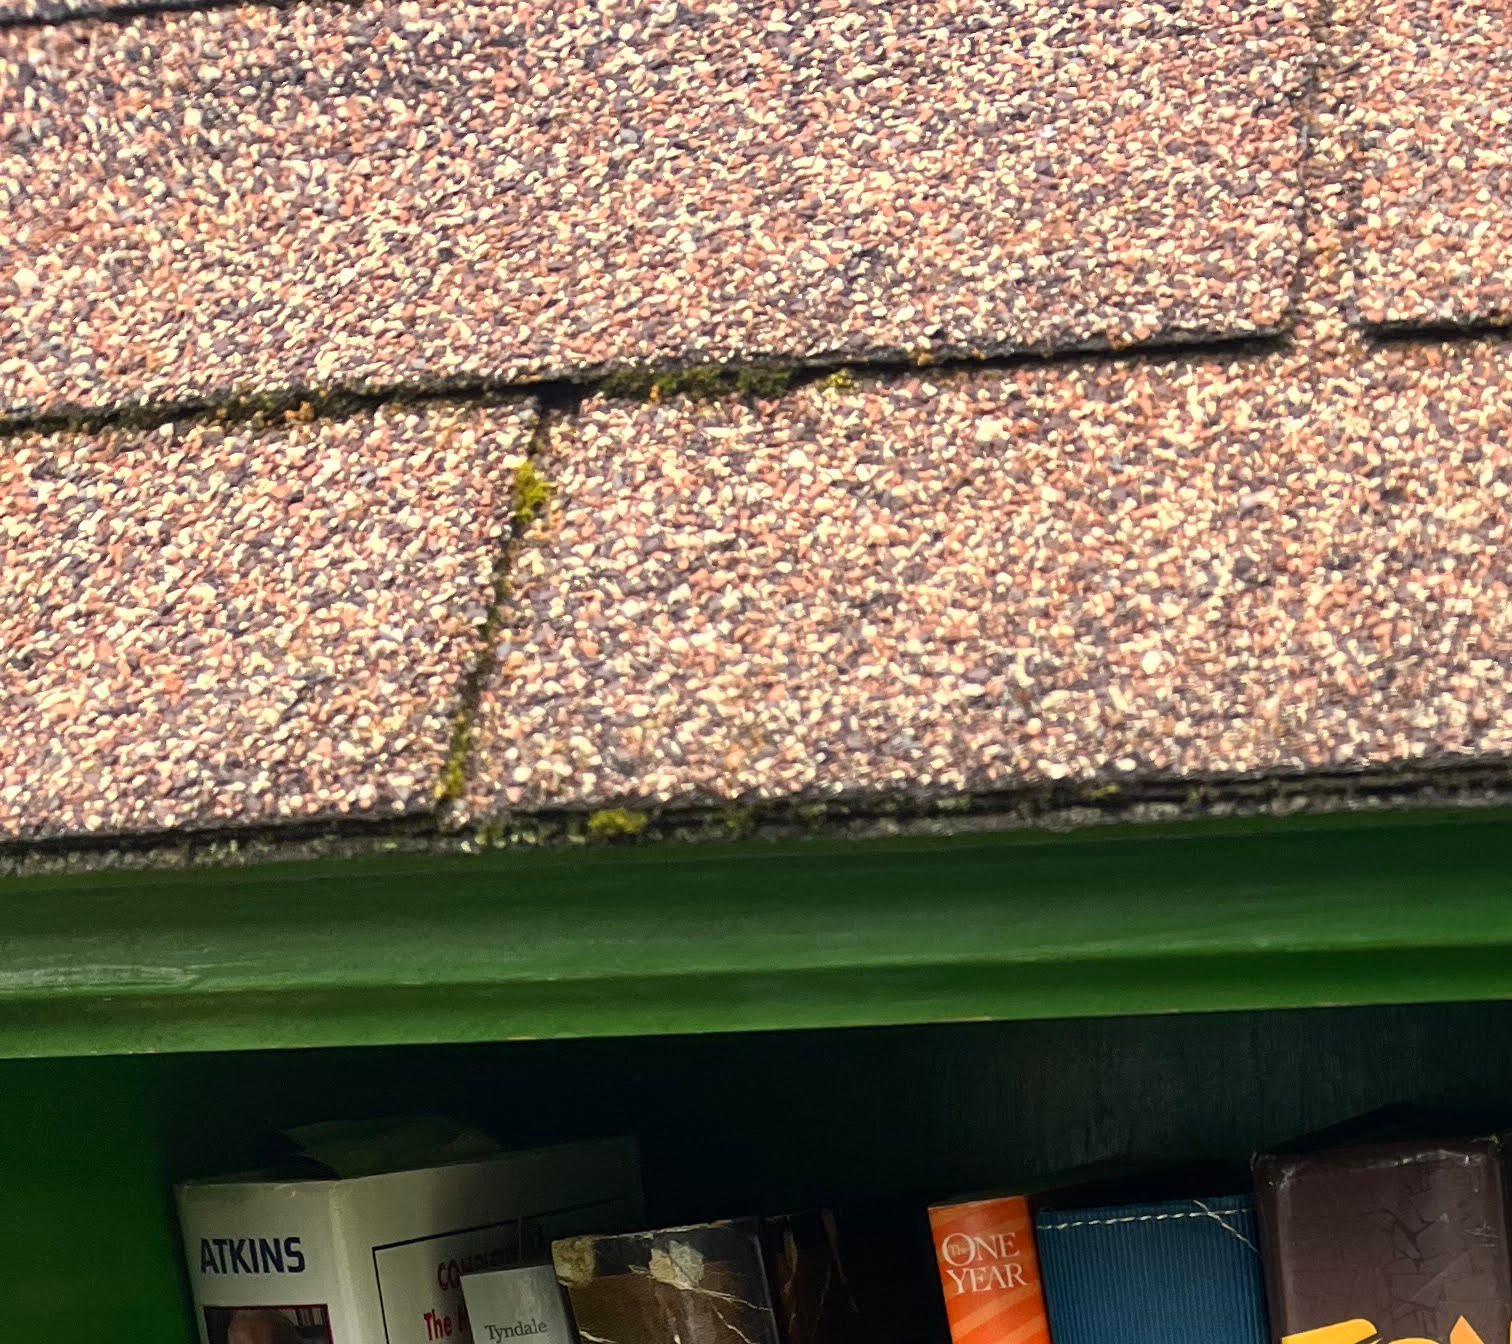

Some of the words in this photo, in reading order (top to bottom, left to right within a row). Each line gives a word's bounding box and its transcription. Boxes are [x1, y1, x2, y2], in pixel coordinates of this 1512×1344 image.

[200, 1236, 305, 1274] ATKINS
[942, 1232, 1020, 1267] ONE
[945, 1264, 1028, 1295] YEAR
[485, 1319, 548, 1343] Tyndale
